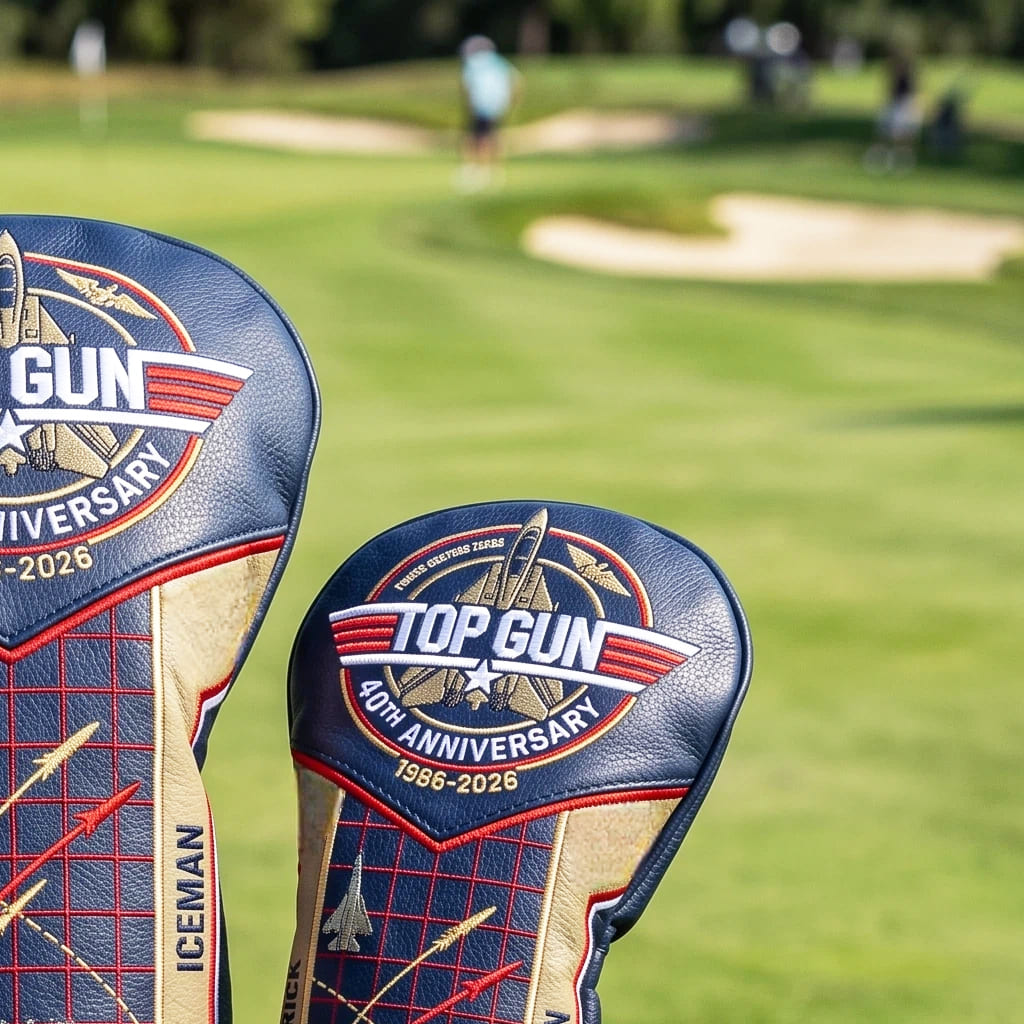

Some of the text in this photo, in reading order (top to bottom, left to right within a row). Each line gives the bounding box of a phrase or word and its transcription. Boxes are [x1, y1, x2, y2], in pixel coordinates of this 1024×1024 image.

[10, 347, 145, 411] GUN
[391, 603, 608, 672] TOP GUN
[360, 679, 601, 762] 40TH ANNIVERSARY
[394, 758, 519, 794] 1986-2026
[175, 824, 205, 972] ICEMAN
